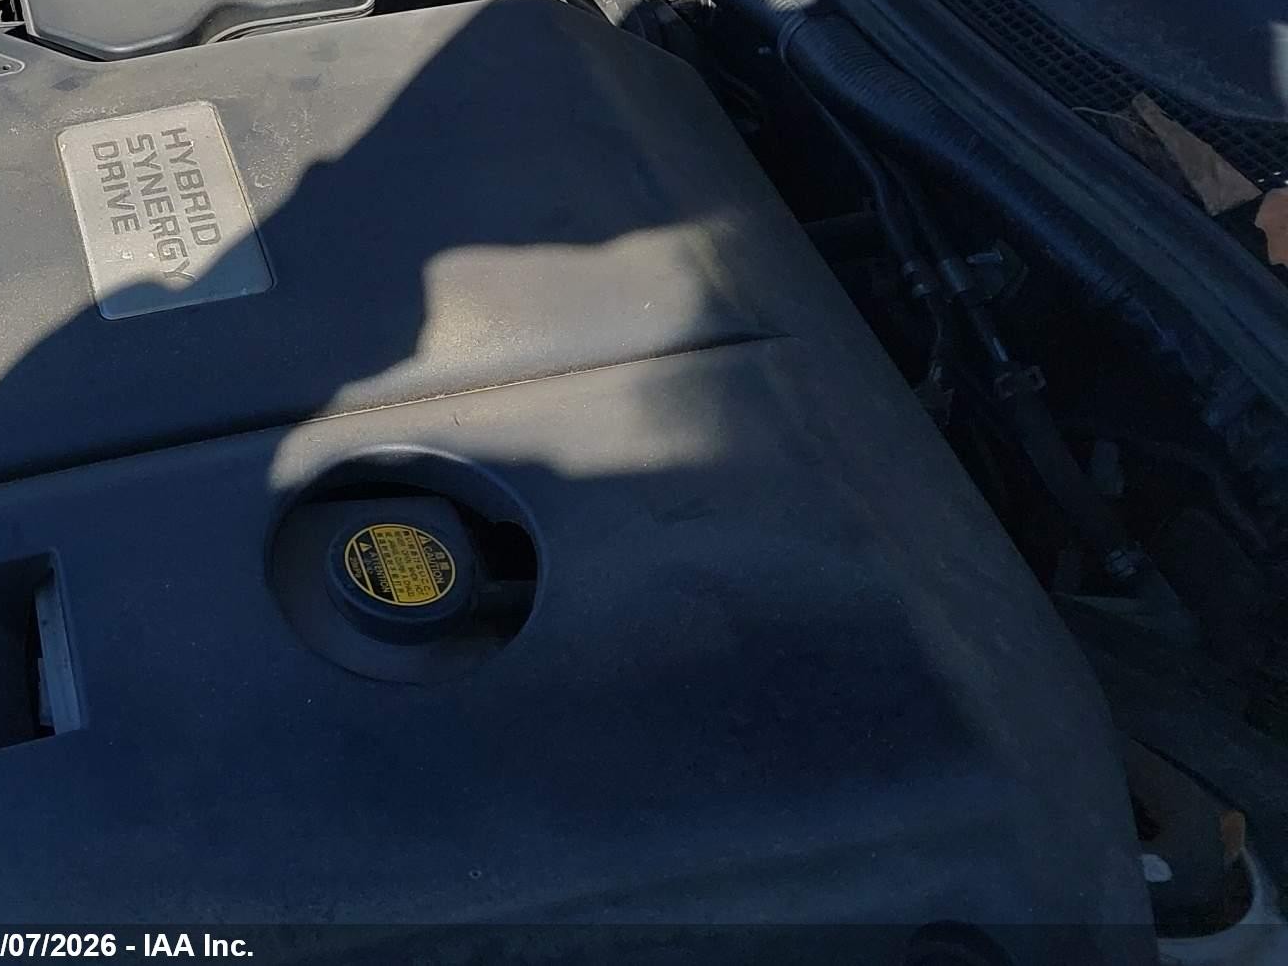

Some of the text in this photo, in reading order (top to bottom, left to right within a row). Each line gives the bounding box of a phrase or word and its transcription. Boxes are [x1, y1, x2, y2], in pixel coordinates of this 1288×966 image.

[92, 140, 140, 234] DRIVE
[125, 134, 195, 281] SYNERGY
[161, 127, 221, 245] HYBRID
[369, 552, 391, 593] ATTENTION
[423, 546, 445, 584] CAUTION
